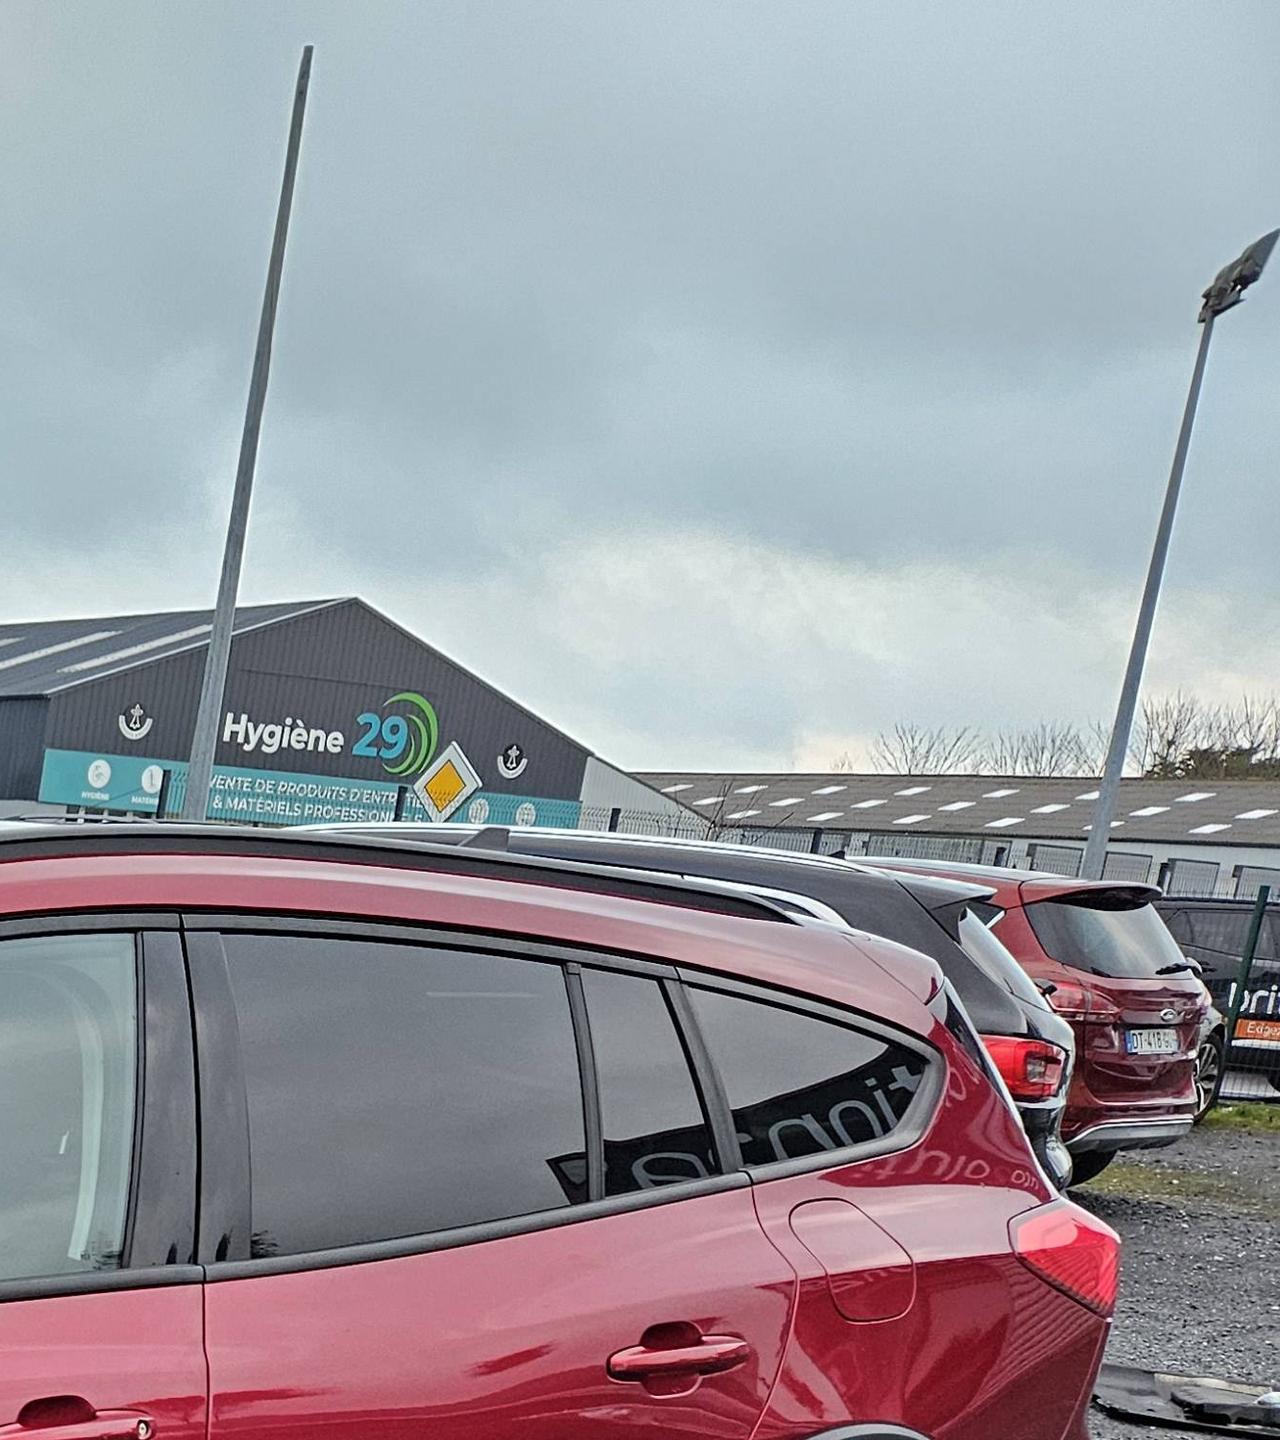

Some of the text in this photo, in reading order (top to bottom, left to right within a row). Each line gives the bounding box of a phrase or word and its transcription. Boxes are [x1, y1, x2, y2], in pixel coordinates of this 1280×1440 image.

[222, 711, 409, 760] Hygiène 29
[255, 778, 275, 793] DE
[277, 780, 347, 801] PRODUITS
[212, 795, 223, 809] &
